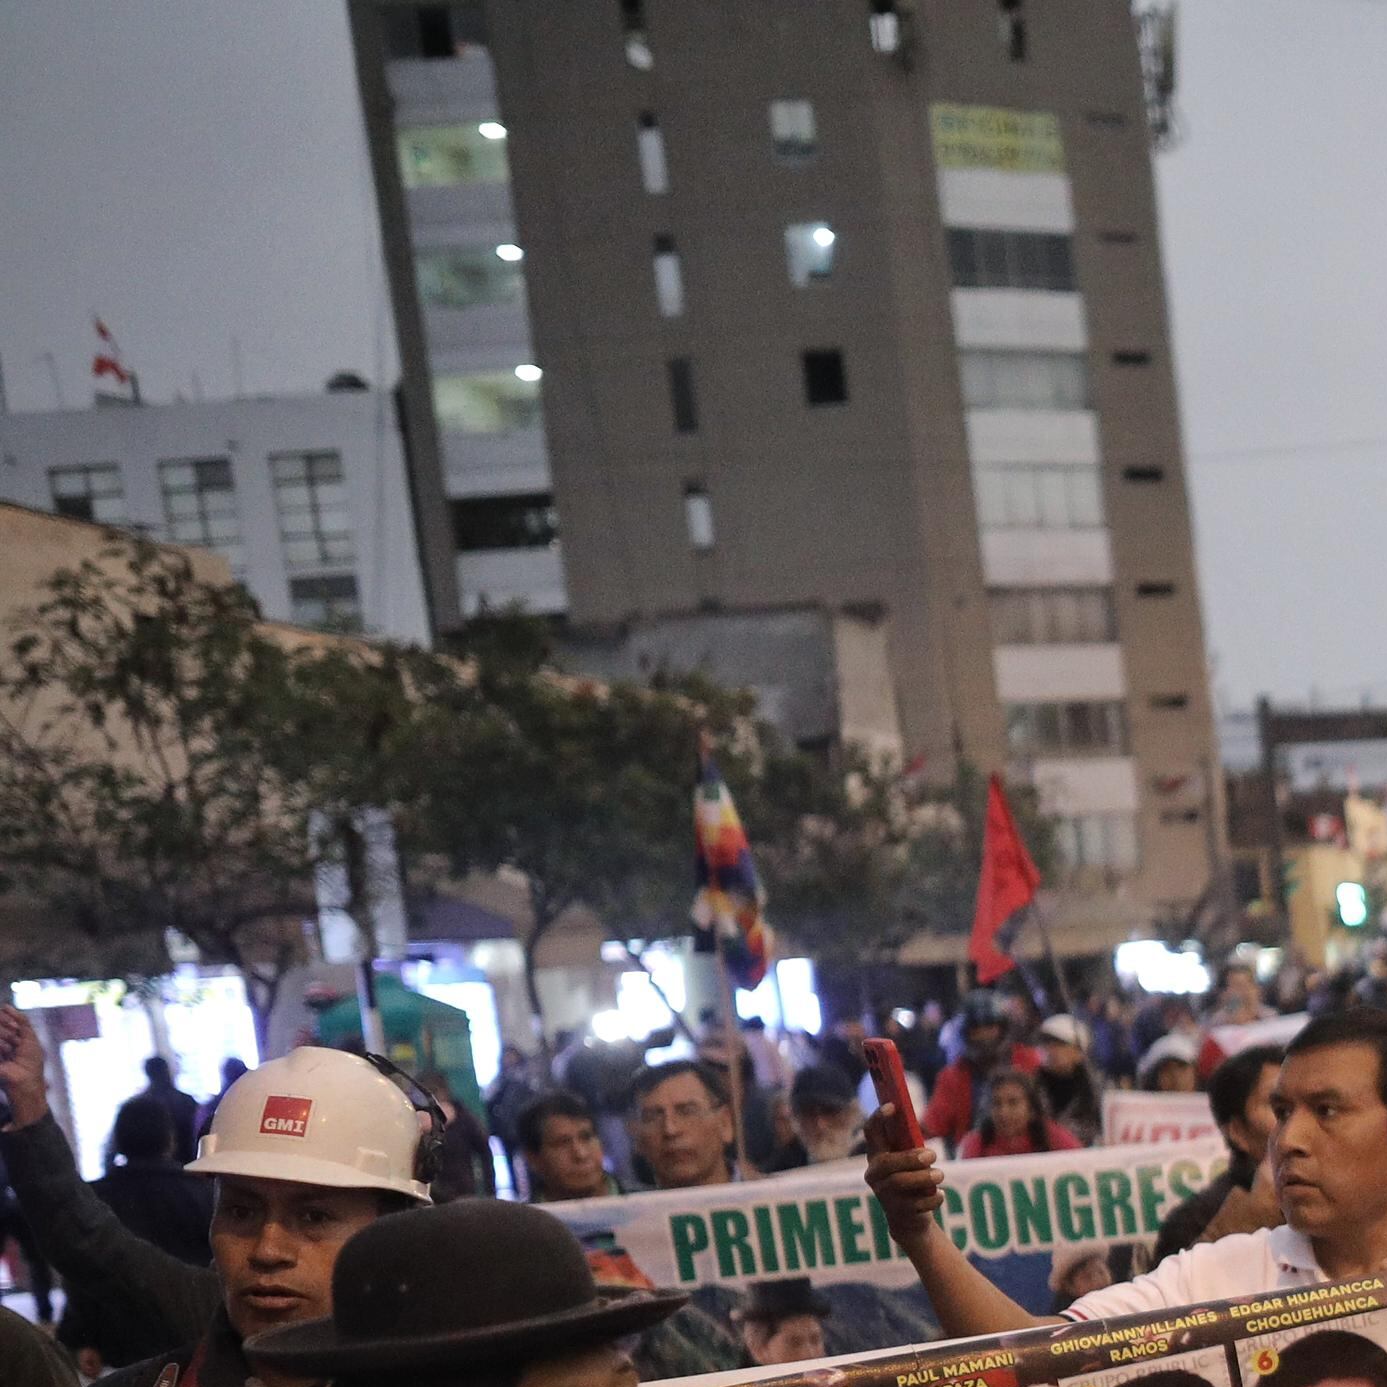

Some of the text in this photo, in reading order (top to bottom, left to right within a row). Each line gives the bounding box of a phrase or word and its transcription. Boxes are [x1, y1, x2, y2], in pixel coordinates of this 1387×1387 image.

[263, 1117, 304, 1133] GMI
[1229, 1298, 1282, 1320] EDGAR
[1286, 1278, 1385, 1308] HUARANCCA
[1245, 1295, 1380, 1333] CHOQUEHUANCA
[1050, 1310, 1218, 1356] GHIOVANNY ILLANES
[1110, 1339, 1169, 1363] RAMOS
[1257, 1349, 1273, 1371] 6
[942, 1352, 1016, 1380] MAMANI
